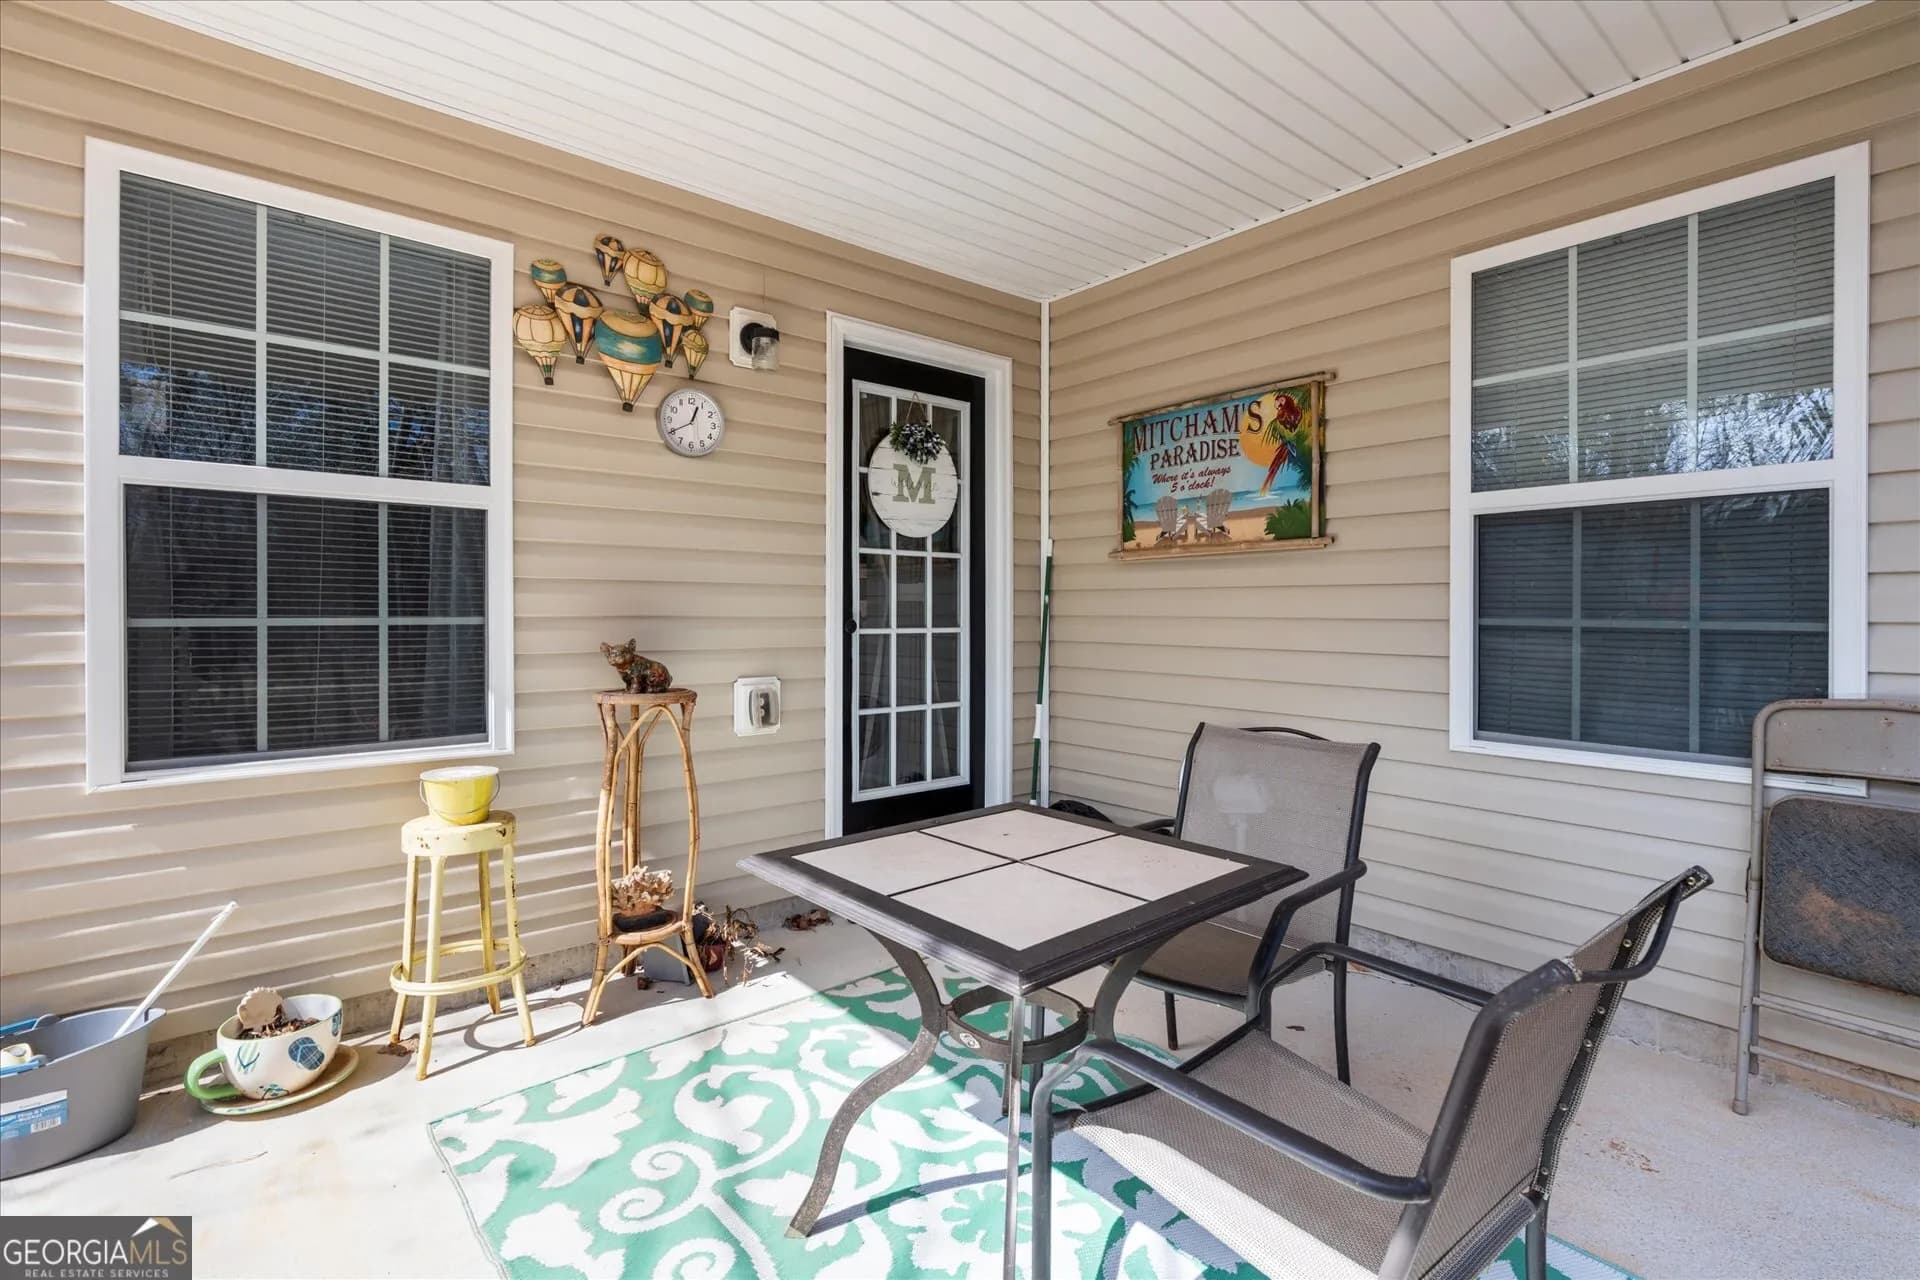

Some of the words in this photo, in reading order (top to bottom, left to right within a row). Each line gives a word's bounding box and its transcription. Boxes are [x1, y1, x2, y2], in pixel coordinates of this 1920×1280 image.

[688, 397, 696, 406] 12
[670, 406, 678, 414] 10
[666, 416, 672, 424] 9
[710, 422, 716, 430] 3
[1132, 400, 1263, 455] MITCHAM'S
[670, 427, 676, 435] 8
[678, 436, 684, 444] 7
[688, 441, 694, 449] 6
[1150, 438, 1241, 471] PARADISE
[1152, 472, 1178, 485] Where
[1181, 468, 1195, 481] it's
[1199, 466, 1232, 479] always
[892, 463, 937, 504] M
[1170, 482, 1178, 493] 5
[1180, 477, 1216, 492] o'clock!
